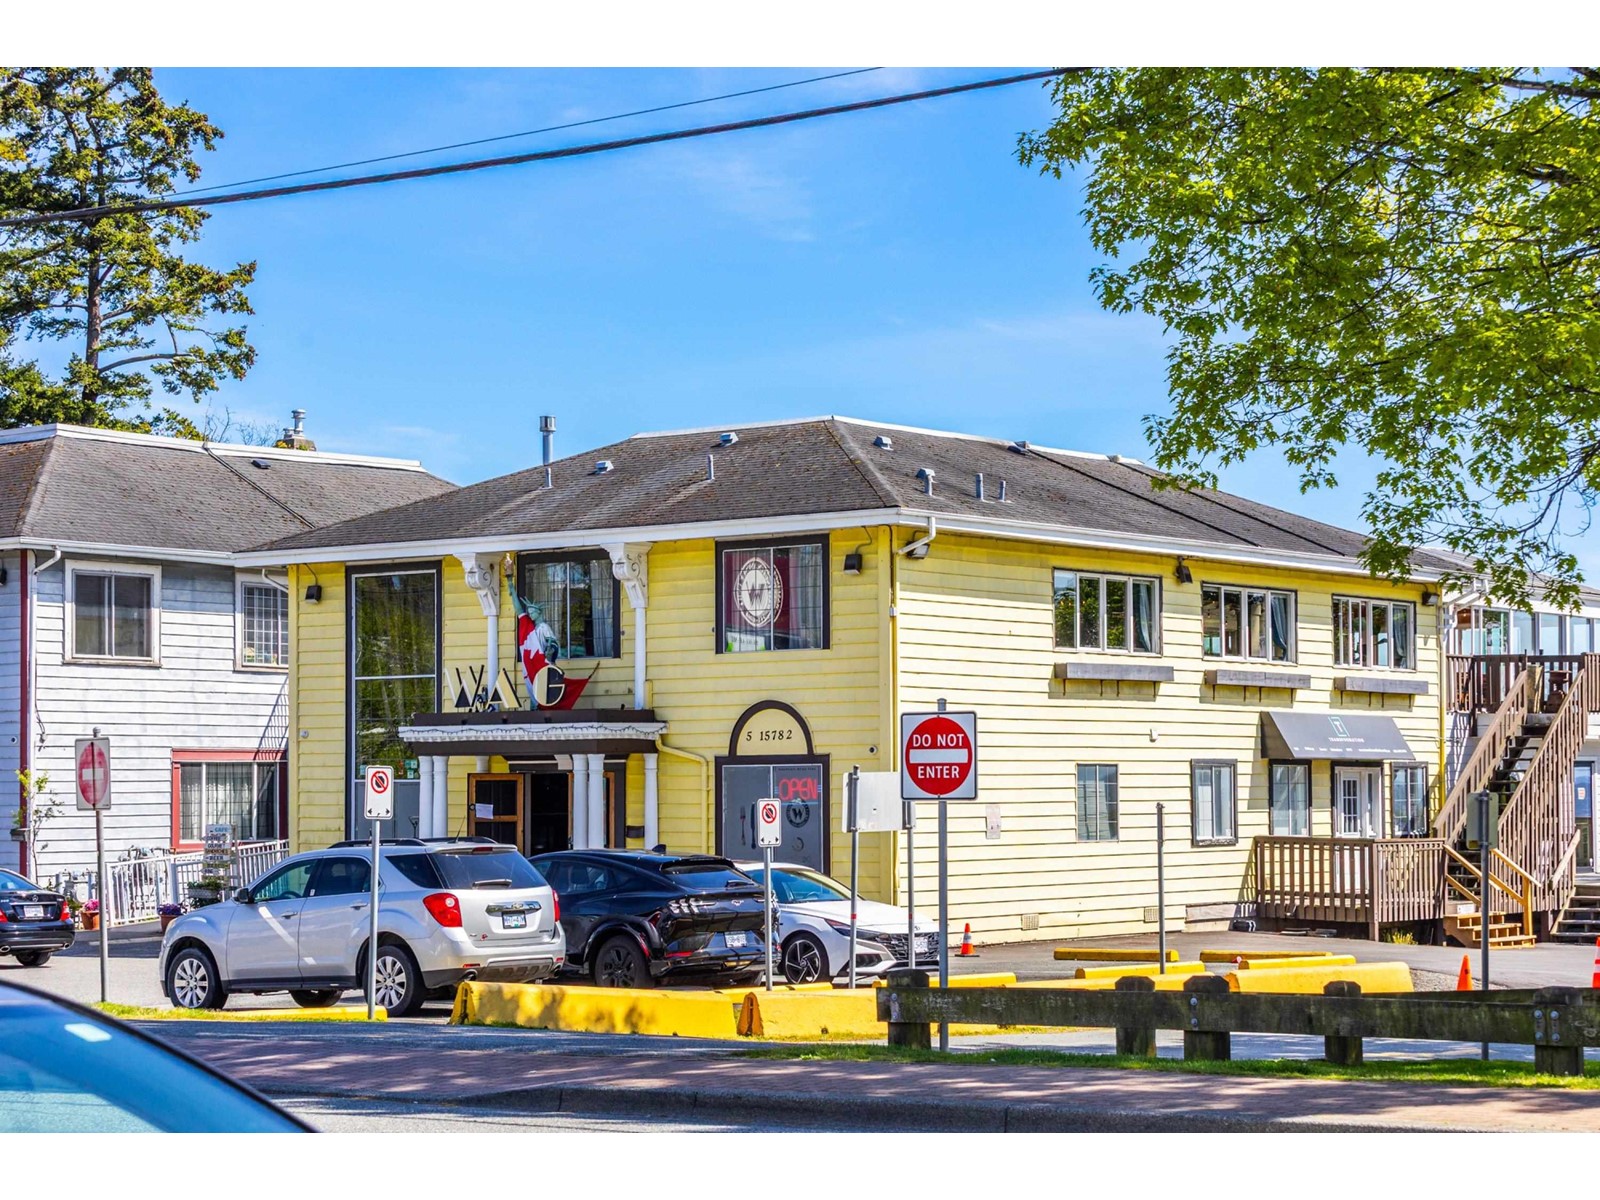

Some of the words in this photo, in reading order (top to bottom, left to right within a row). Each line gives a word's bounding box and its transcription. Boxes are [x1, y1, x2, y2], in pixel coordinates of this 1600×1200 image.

[444, 664, 566, 708] WAG
[745, 731, 753, 742] 5
[759, 729, 793, 741] 15782
[912, 733, 932, 747] DO
[937, 733, 964, 747] NOT
[917, 765, 960, 779] ENTER
[779, 778, 817, 800] OPEN
